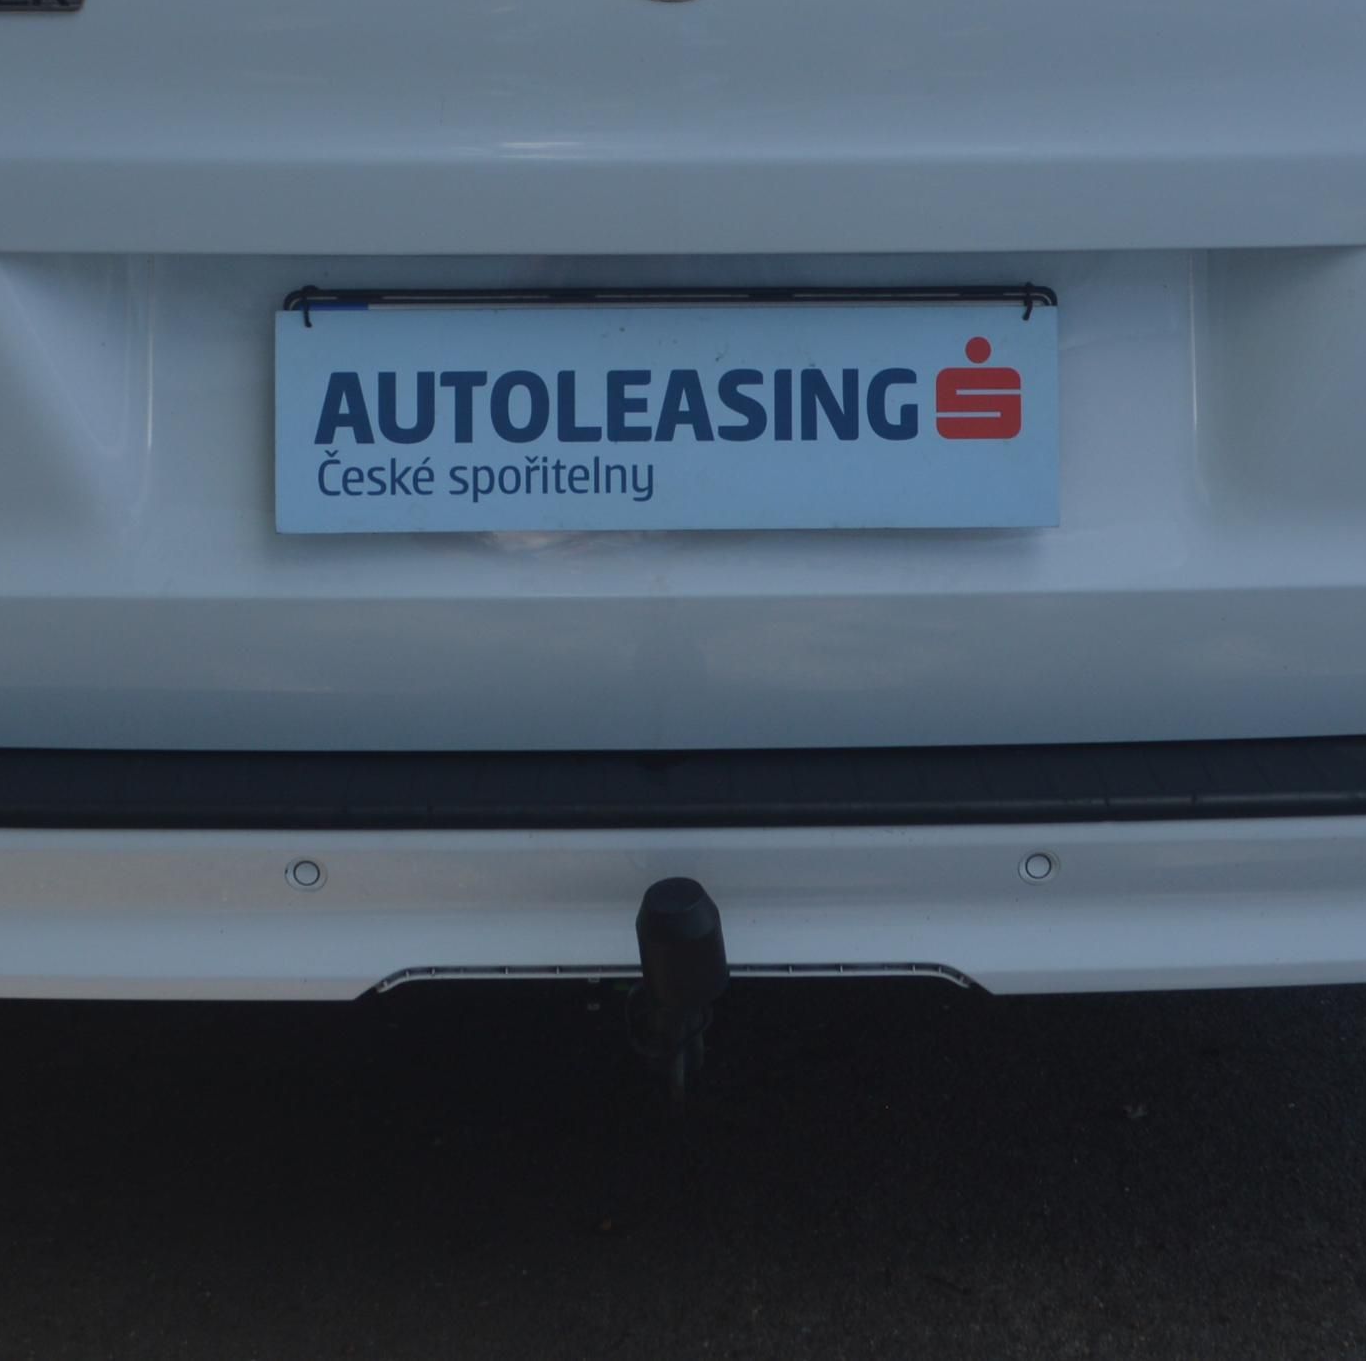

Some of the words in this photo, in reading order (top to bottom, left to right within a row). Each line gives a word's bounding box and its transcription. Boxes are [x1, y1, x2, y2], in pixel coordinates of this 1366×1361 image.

[314, 368, 919, 445] AUTOLEASING
[318, 449, 435, 497] České
[448, 455, 654, 503] spořitelny
